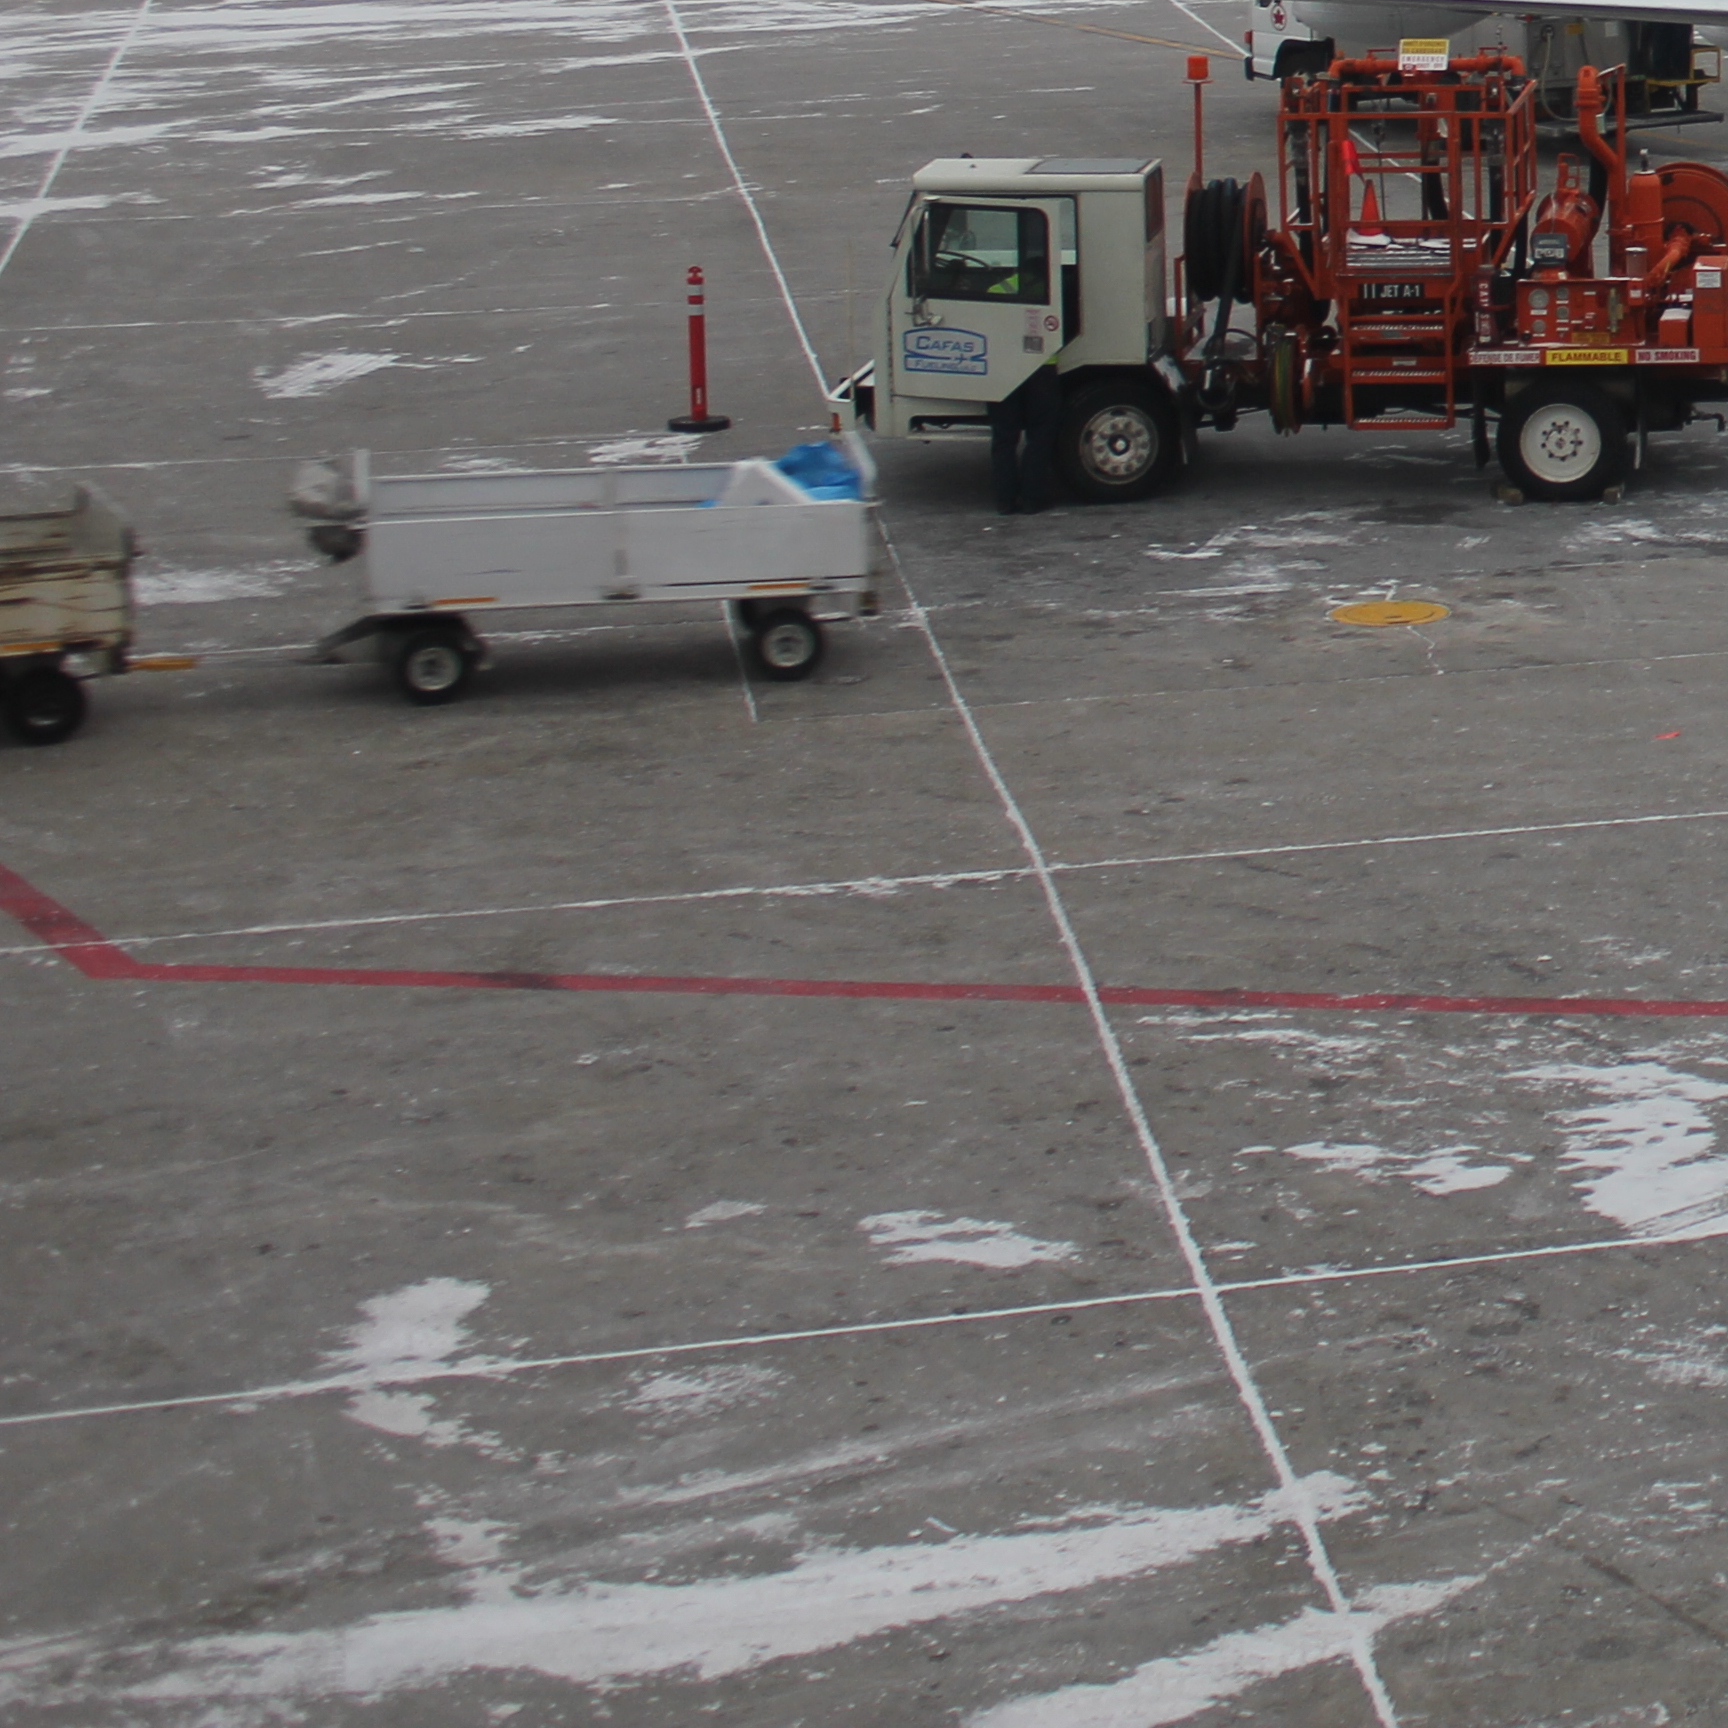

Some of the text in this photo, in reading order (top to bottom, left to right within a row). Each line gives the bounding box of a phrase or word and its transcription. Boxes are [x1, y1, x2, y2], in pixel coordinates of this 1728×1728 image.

[1381, 284, 1420, 298] JET A-1
[916, 335, 974, 353] CAFAS
[1551, 352, 1622, 362] FLAMMABLE
[1638, 351, 1696, 361] NO SMOKING
